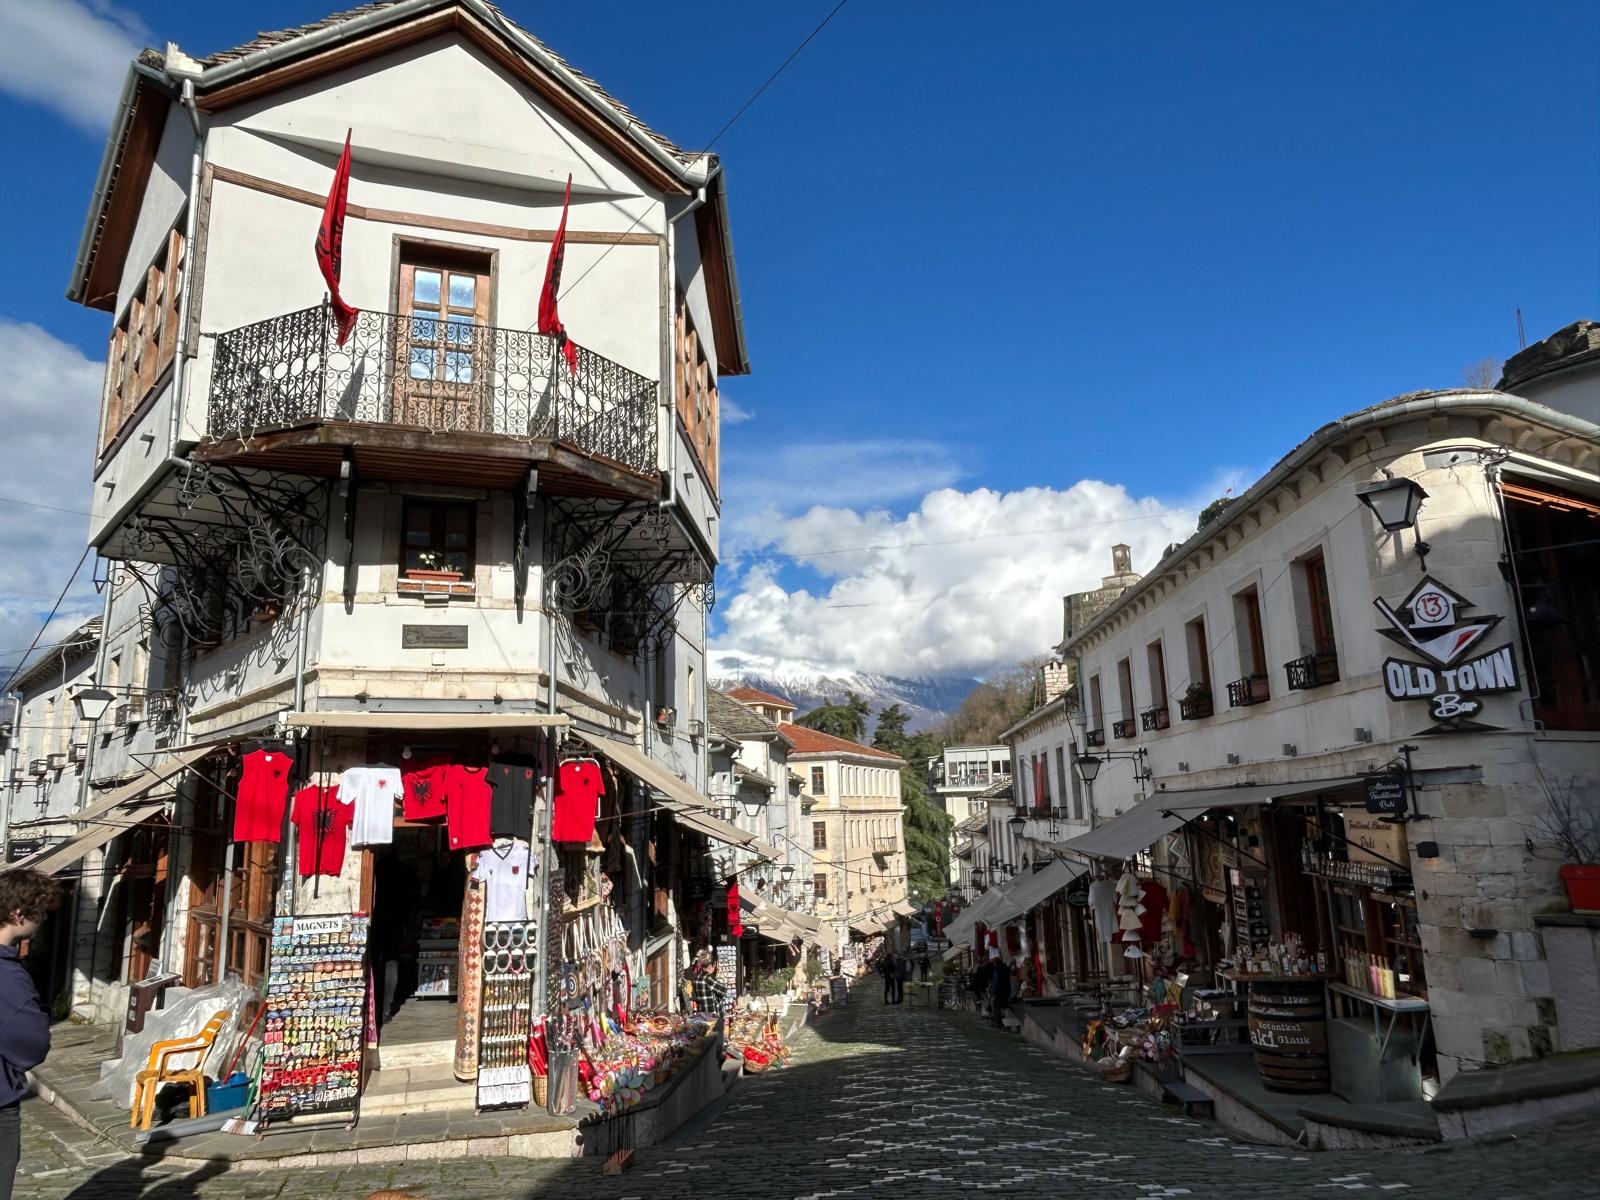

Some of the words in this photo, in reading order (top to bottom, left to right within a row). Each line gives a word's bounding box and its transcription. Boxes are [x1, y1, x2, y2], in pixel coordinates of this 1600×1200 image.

[1421, 597, 1442, 617] 13
[1386, 661, 1437, 697] OLD
[1441, 648, 1516, 692] TOWN
[1432, 693, 1478, 717] Bar
[296, 920, 339, 931] MAGNETS
[1251, 1029, 1279, 1047] aki
